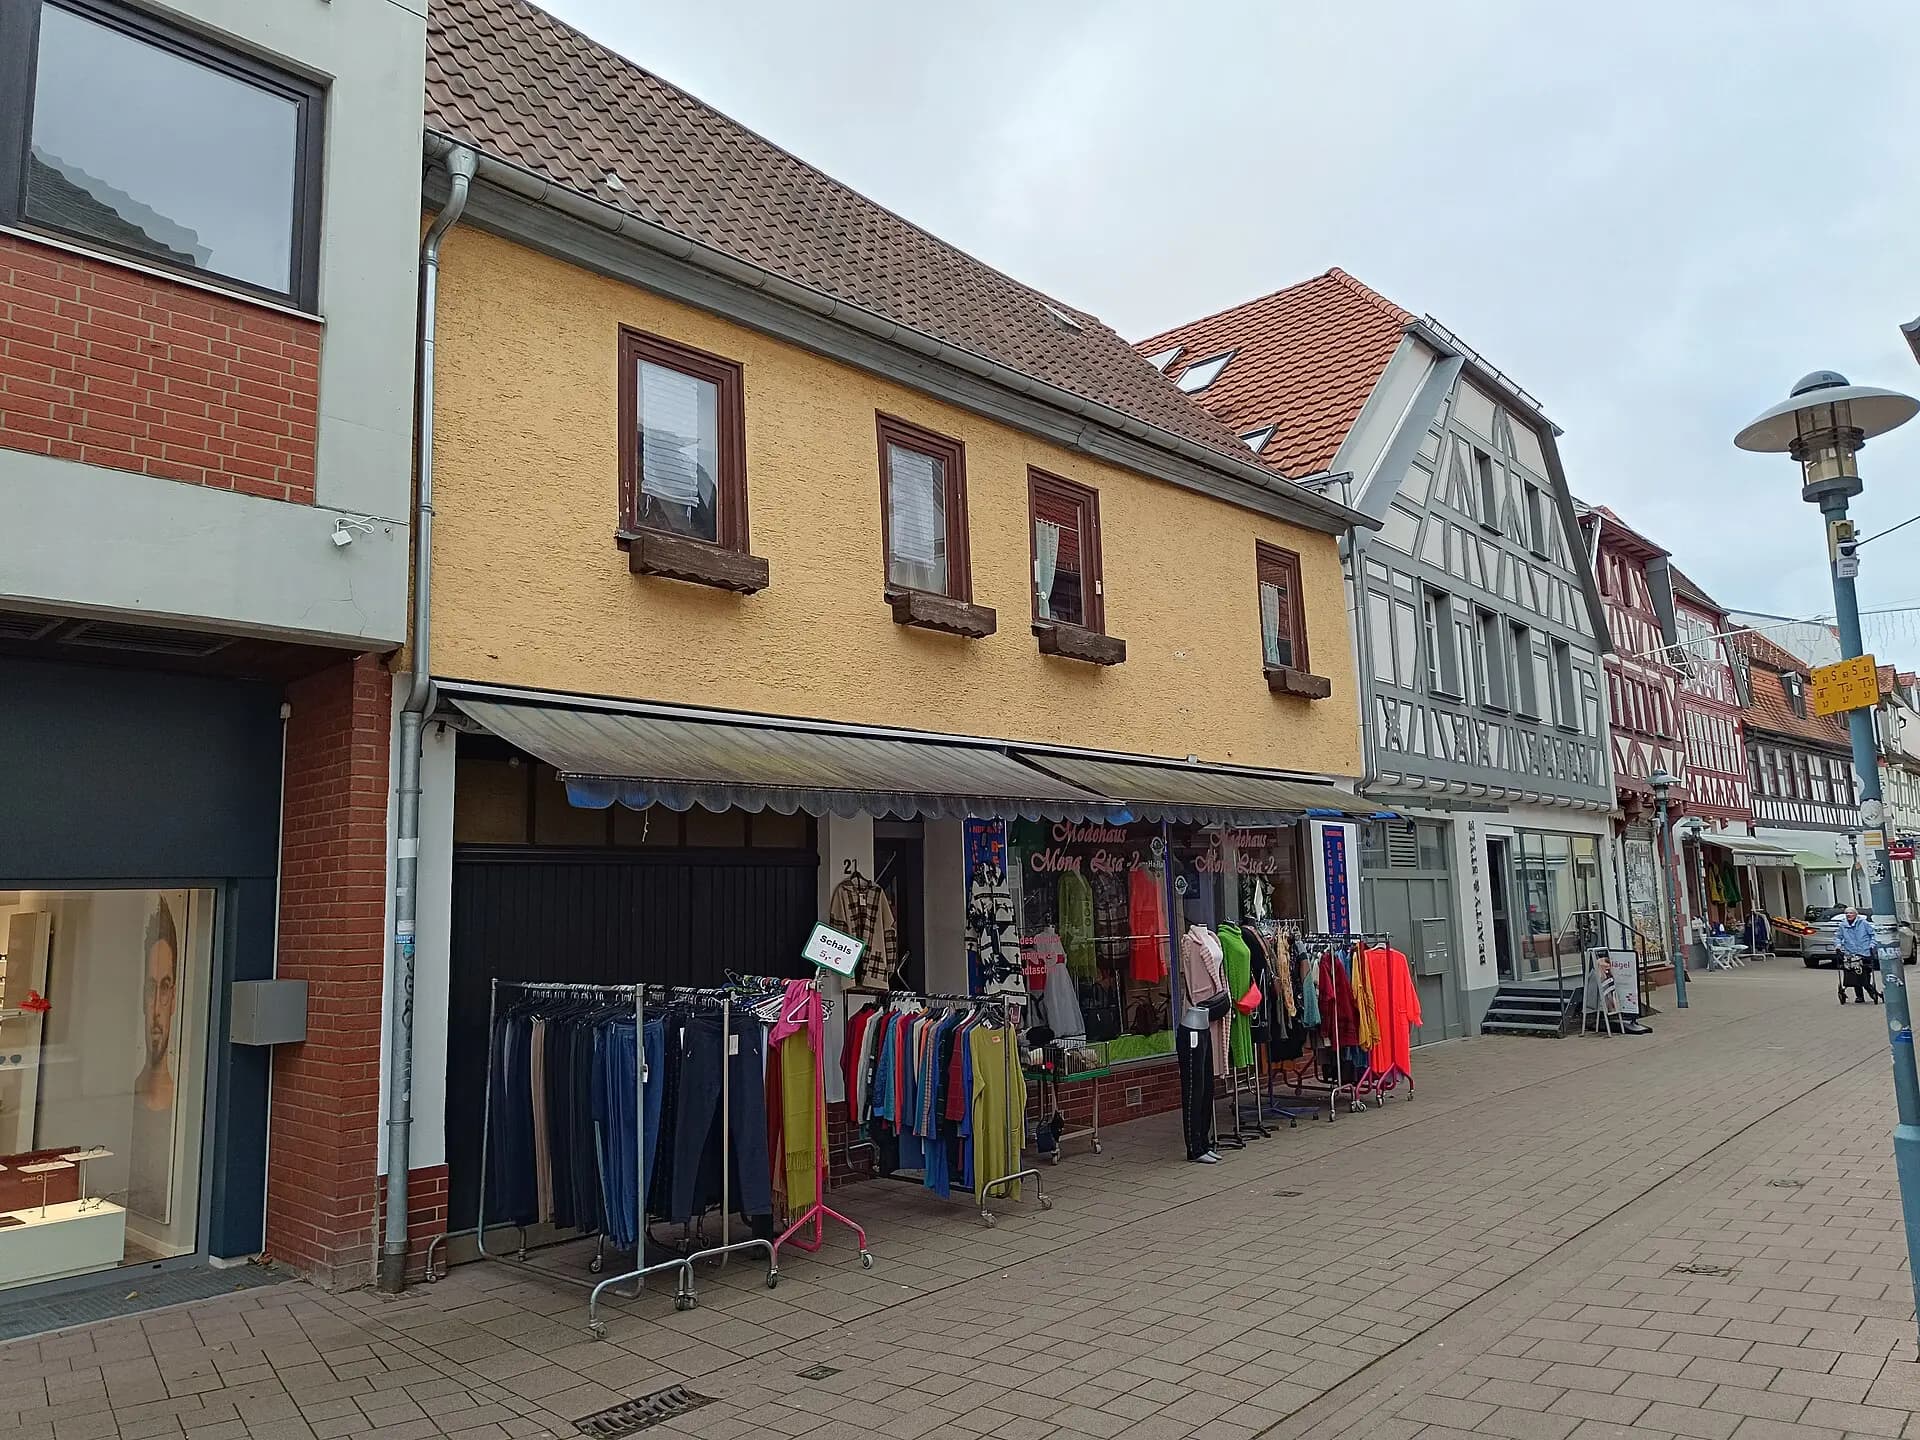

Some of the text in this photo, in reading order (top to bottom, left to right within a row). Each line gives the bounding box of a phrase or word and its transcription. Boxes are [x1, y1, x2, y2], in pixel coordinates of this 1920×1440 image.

[843, 858, 857, 874] 21
[1031, 848, 1082, 872] Mona
[1090, 849, 1125, 875] Lisa
[1237, 853, 1263, 873] Lisa
[1468, 820, 1486, 966] BEAUTY & STYLE
[819, 935, 852, 955] Schals
[834, 956, 842, 965] €
